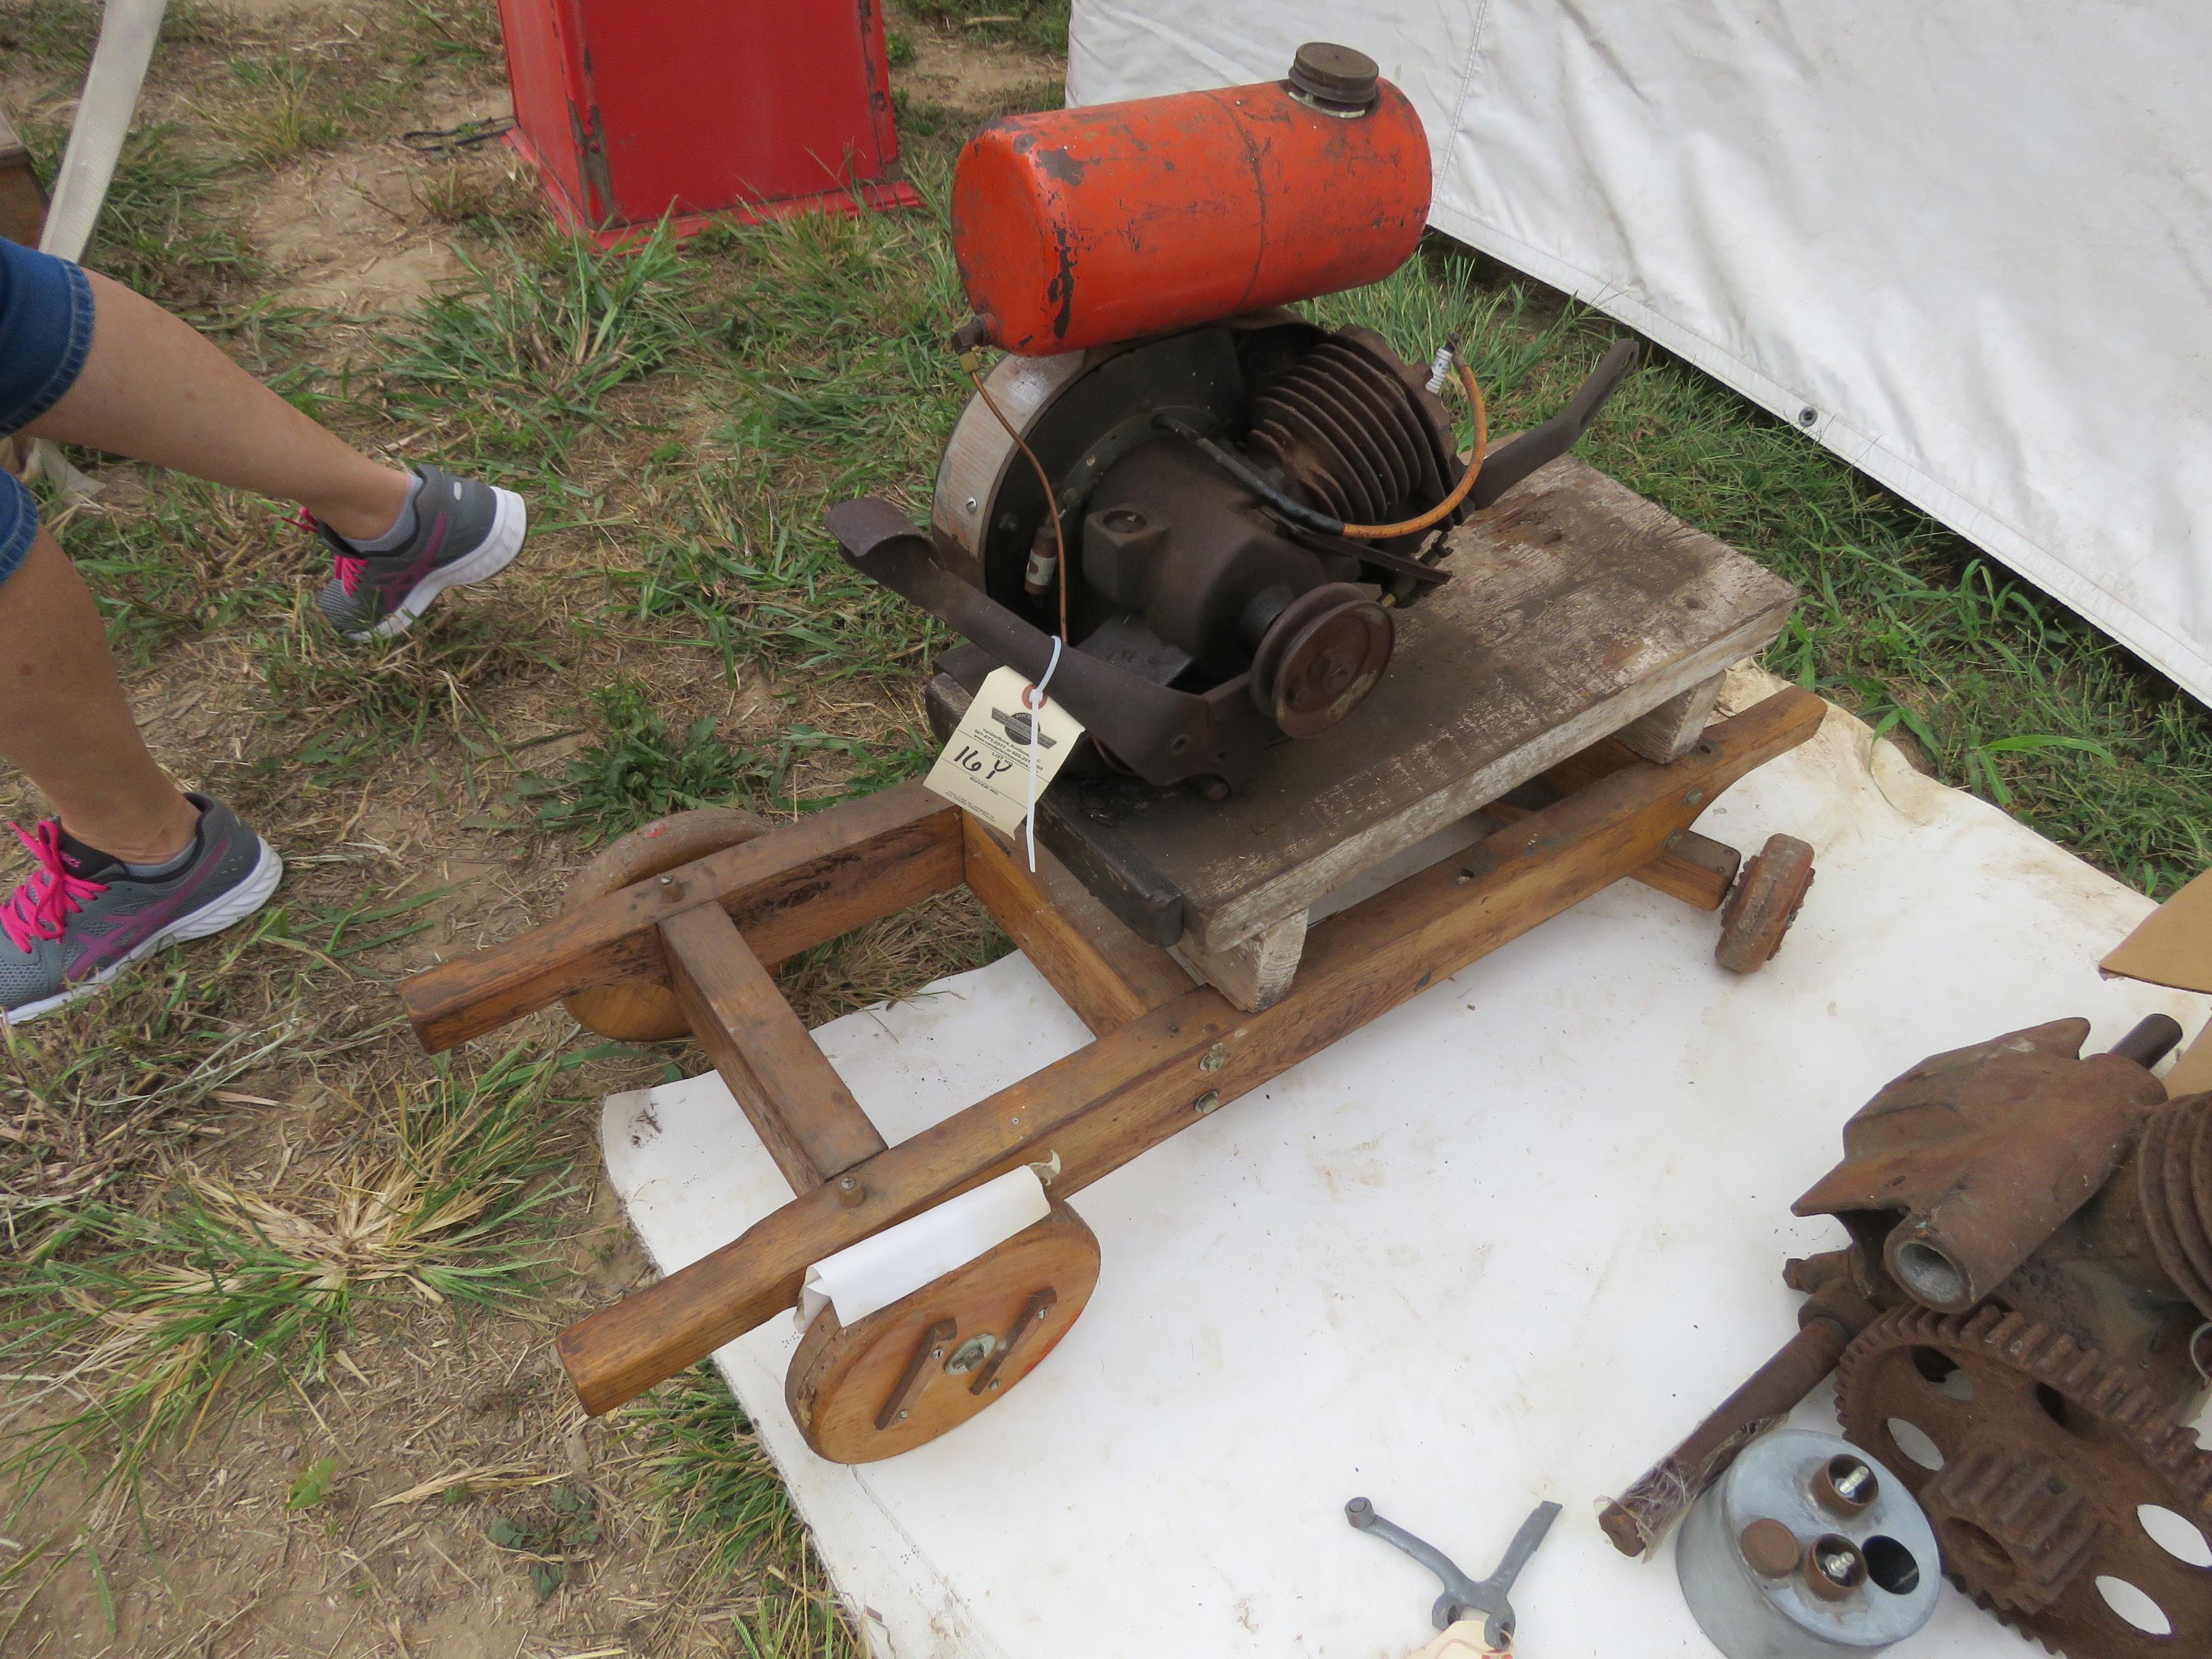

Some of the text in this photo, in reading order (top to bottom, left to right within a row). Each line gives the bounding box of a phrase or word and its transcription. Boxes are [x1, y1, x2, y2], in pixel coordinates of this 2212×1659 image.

[982, 728, 1010, 745] VanDerBrink
[991, 752, 1004, 761] LOT
[969, 776, 989, 791] BUYER
